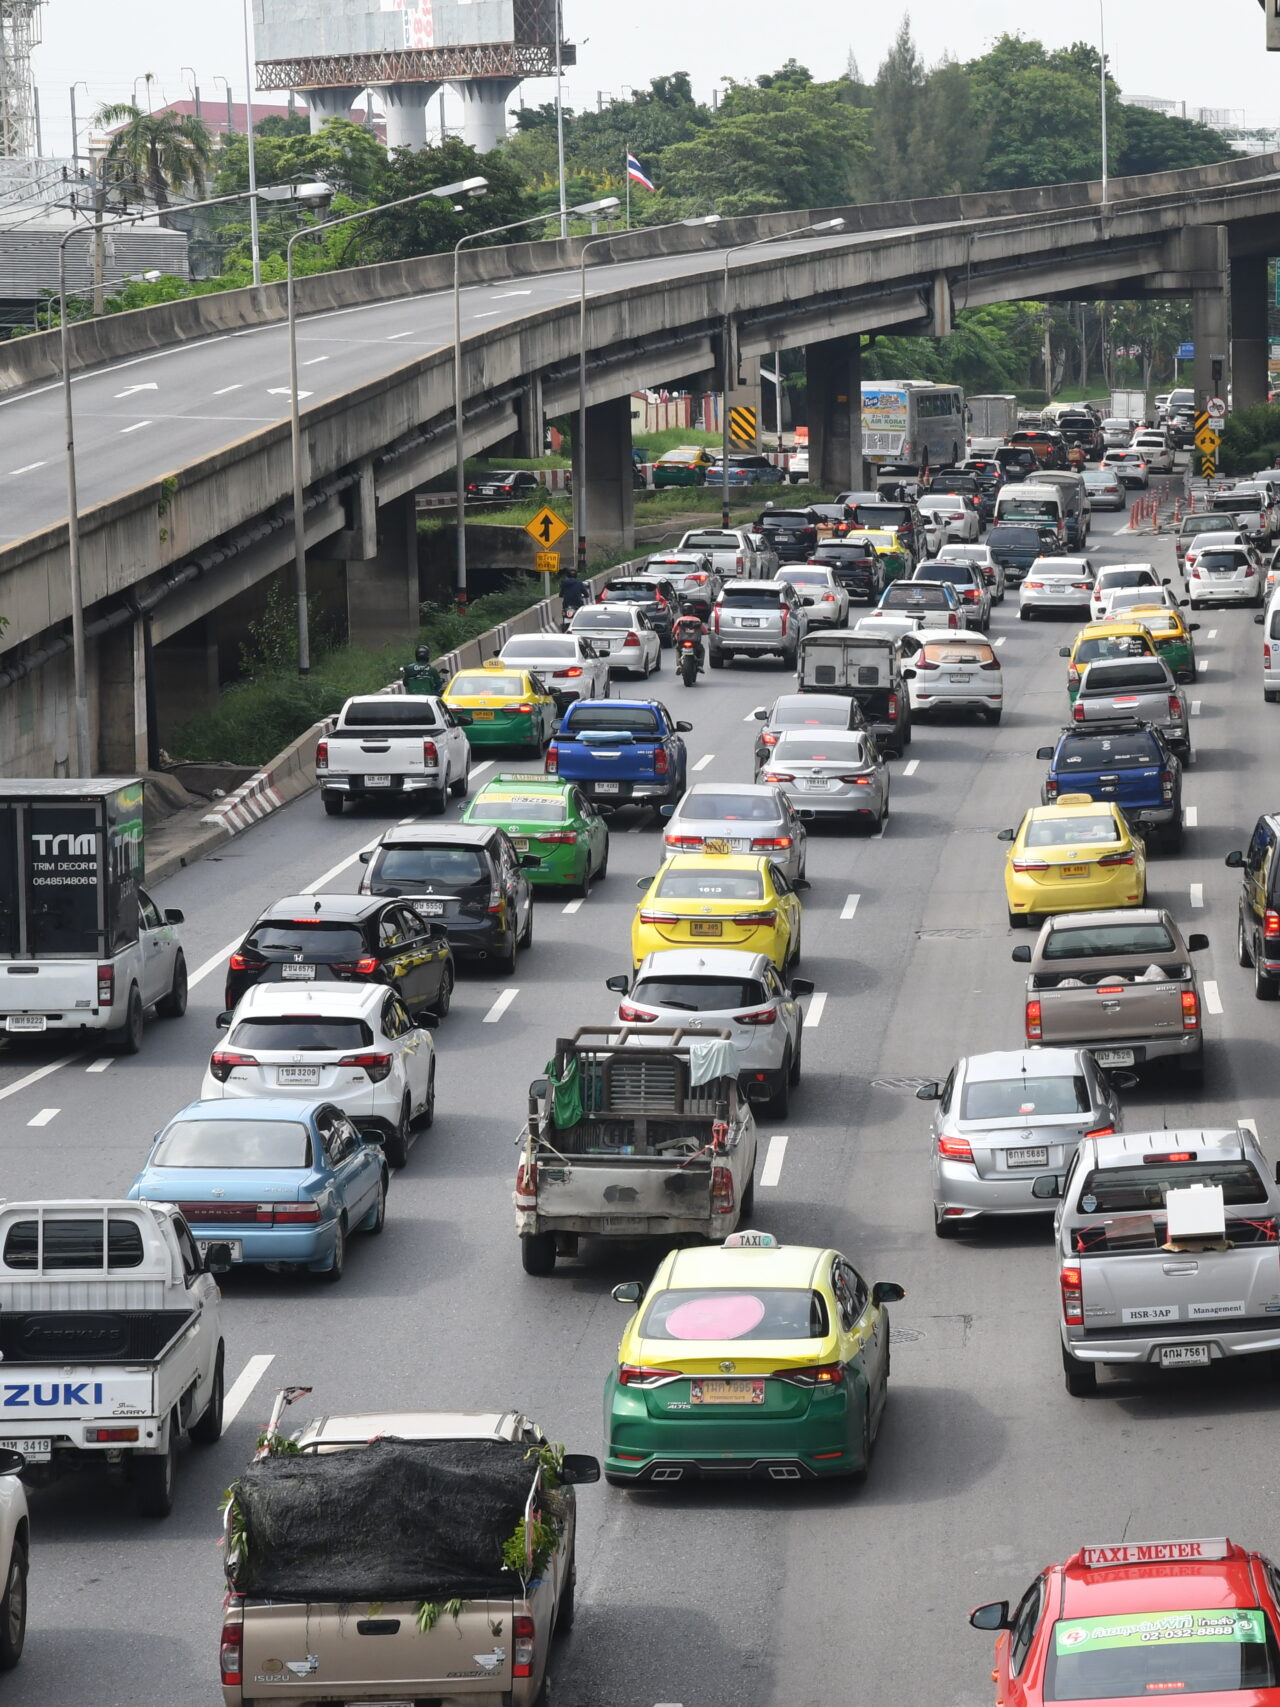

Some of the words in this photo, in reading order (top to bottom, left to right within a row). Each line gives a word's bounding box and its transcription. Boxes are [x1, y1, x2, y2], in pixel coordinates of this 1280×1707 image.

[33, 862, 55, 871] TRIM
[58, 862, 89, 871] DECOR
[33, 877, 89, 886] 0648514806
[297, 1067, 317, 1076] 3209
[739, 1235, 761, 1246] TAXI
[1130, 1309, 1171, 1319] HSR-3AP
[1192, 1304, 1242, 1316] Management
[1184, 1348, 1206, 1357] 7561
[4, 1383, 103, 1407] ZUKI
[23, 1441, 50, 1451] 3419
[1084, 1543, 1203, 1566] TAXI-METER
[1139, 1626, 1235, 1643] 02-032-8888
[254, 1674, 291, 1682] ISUZU
